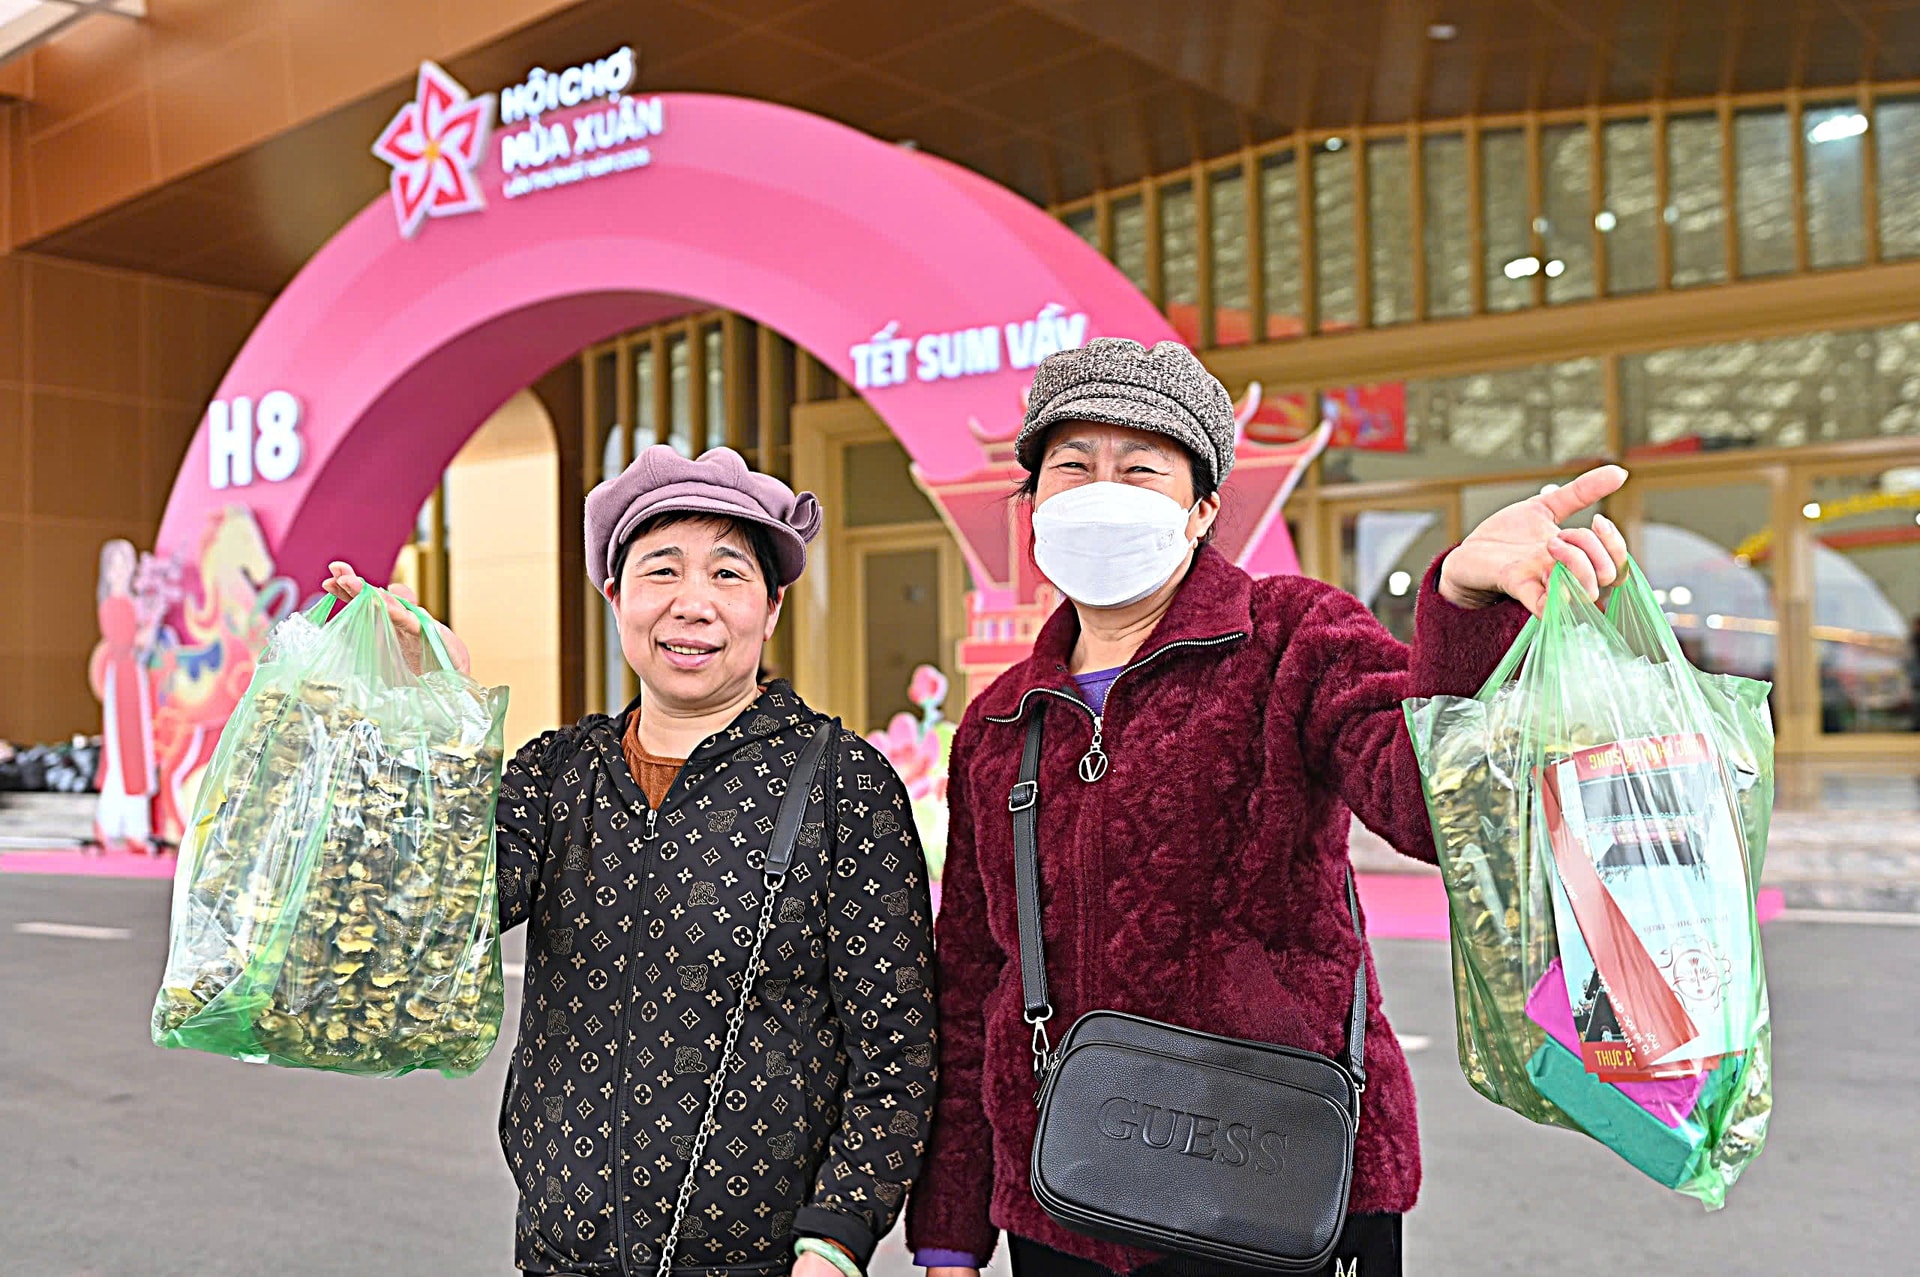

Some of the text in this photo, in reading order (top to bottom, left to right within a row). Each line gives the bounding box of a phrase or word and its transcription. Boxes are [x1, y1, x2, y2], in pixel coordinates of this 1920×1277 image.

[501, 46, 634, 124] HỘI CHỢ
[501, 120, 570, 173] MÙA
[573, 96, 663, 155] XUÂN
[849, 320, 913, 389] TẾT
[916, 326, 1000, 382] SUM
[208, 390, 301, 490] H8
[1594, 1049, 1624, 1069] THỰC
[1099, 1096, 1289, 1177] GUESS
